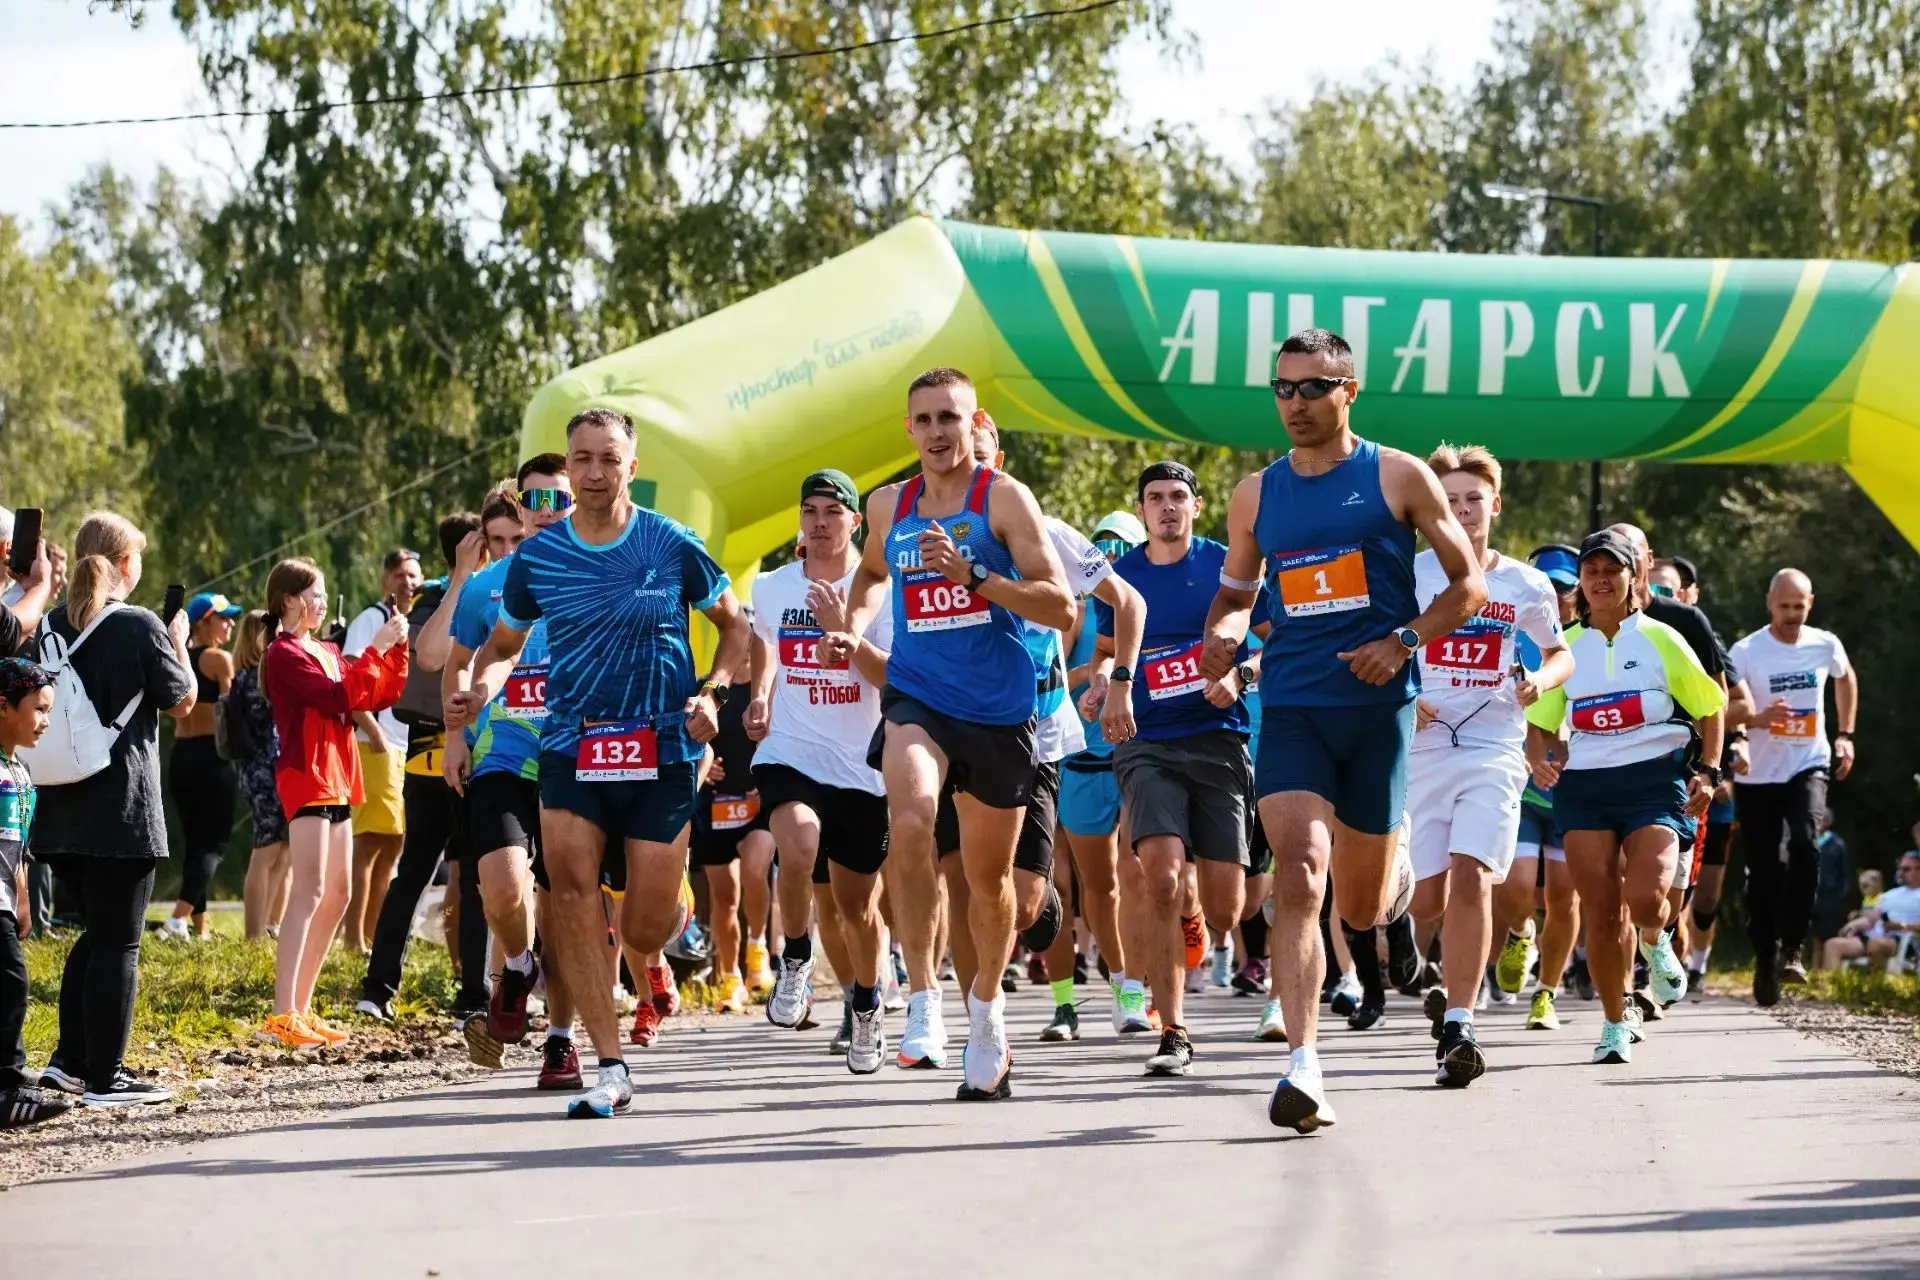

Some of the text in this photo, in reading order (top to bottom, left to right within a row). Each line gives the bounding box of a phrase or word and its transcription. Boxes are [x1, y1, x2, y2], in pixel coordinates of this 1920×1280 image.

[1158, 288, 1691, 398] АНГАРСК
[1314, 570, 1333, 595] 1
[918, 584, 972, 613] 108
[781, 608, 820, 627] #ЗАБ
[1480, 601, 1516, 624] 2025
[793, 642, 820, 664] 11
[1441, 641, 1489, 664] 117
[1156, 656, 1200, 685] 131
[520, 681, 546, 703] 10
[809, 682, 861, 705] С ТОБОЙ
[1592, 708, 1624, 728] 63
[1785, 720, 1807, 735] 32
[591, 740, 642, 764] 132
[7, 800, 21, 823] 1
[727, 804, 748, 819] 16
